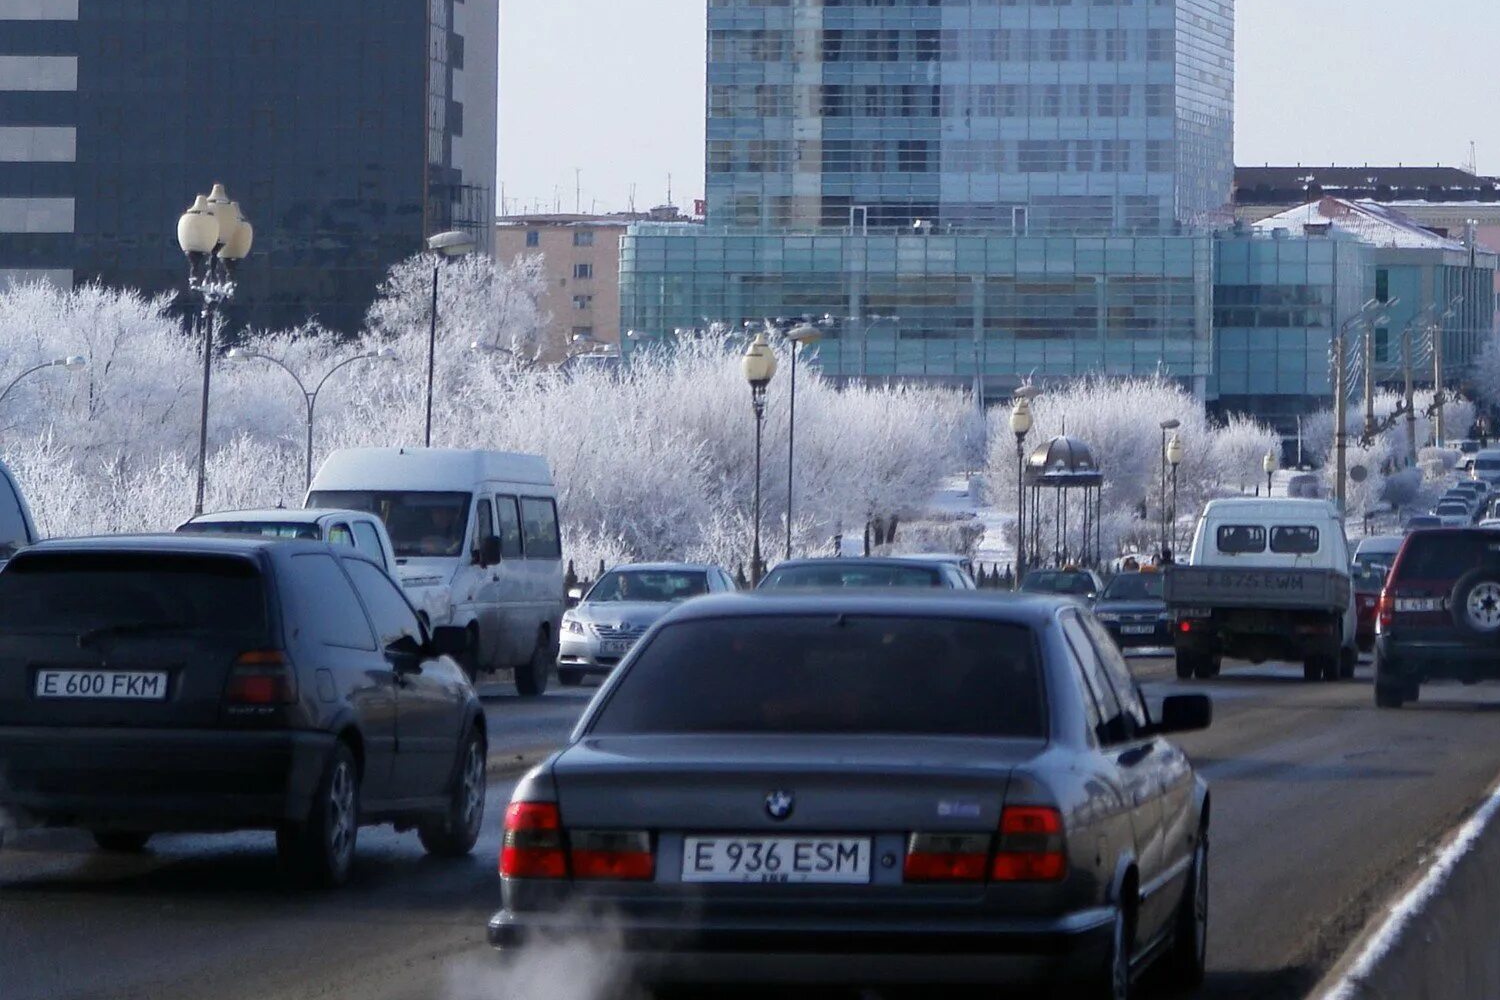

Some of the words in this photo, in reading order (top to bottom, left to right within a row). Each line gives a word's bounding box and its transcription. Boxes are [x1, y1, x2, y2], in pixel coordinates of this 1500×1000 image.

[44, 673, 59, 694] E
[66, 674, 105, 695] 600
[111, 674, 159, 696] FKM
[695, 842, 715, 872] E
[726, 842, 781, 873] 936
[793, 842, 860, 873] ESM
